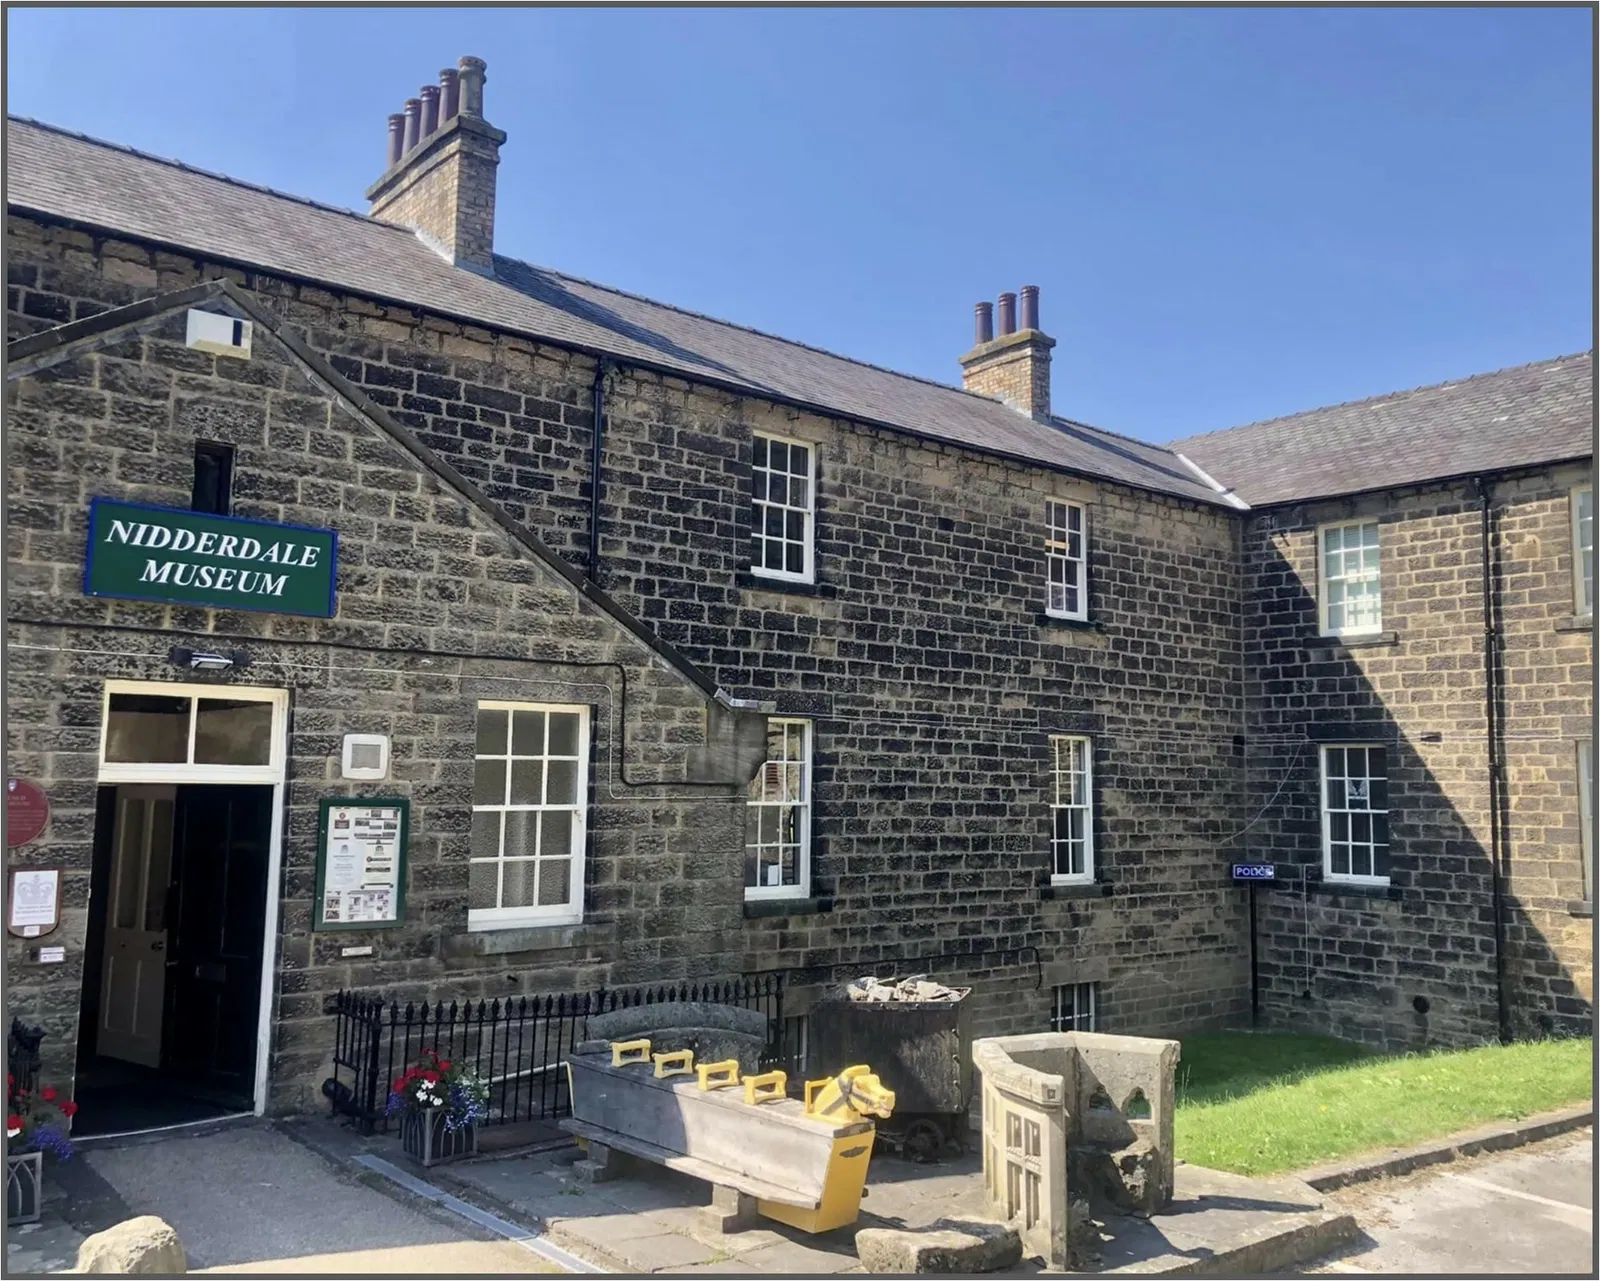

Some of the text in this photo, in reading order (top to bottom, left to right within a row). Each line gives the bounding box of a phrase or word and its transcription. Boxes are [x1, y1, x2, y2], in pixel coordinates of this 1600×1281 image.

[104, 519, 321, 567] NIDDERDALE
[139, 559, 289, 597] MUSEUM
[1236, 867, 1272, 876] POLICE
